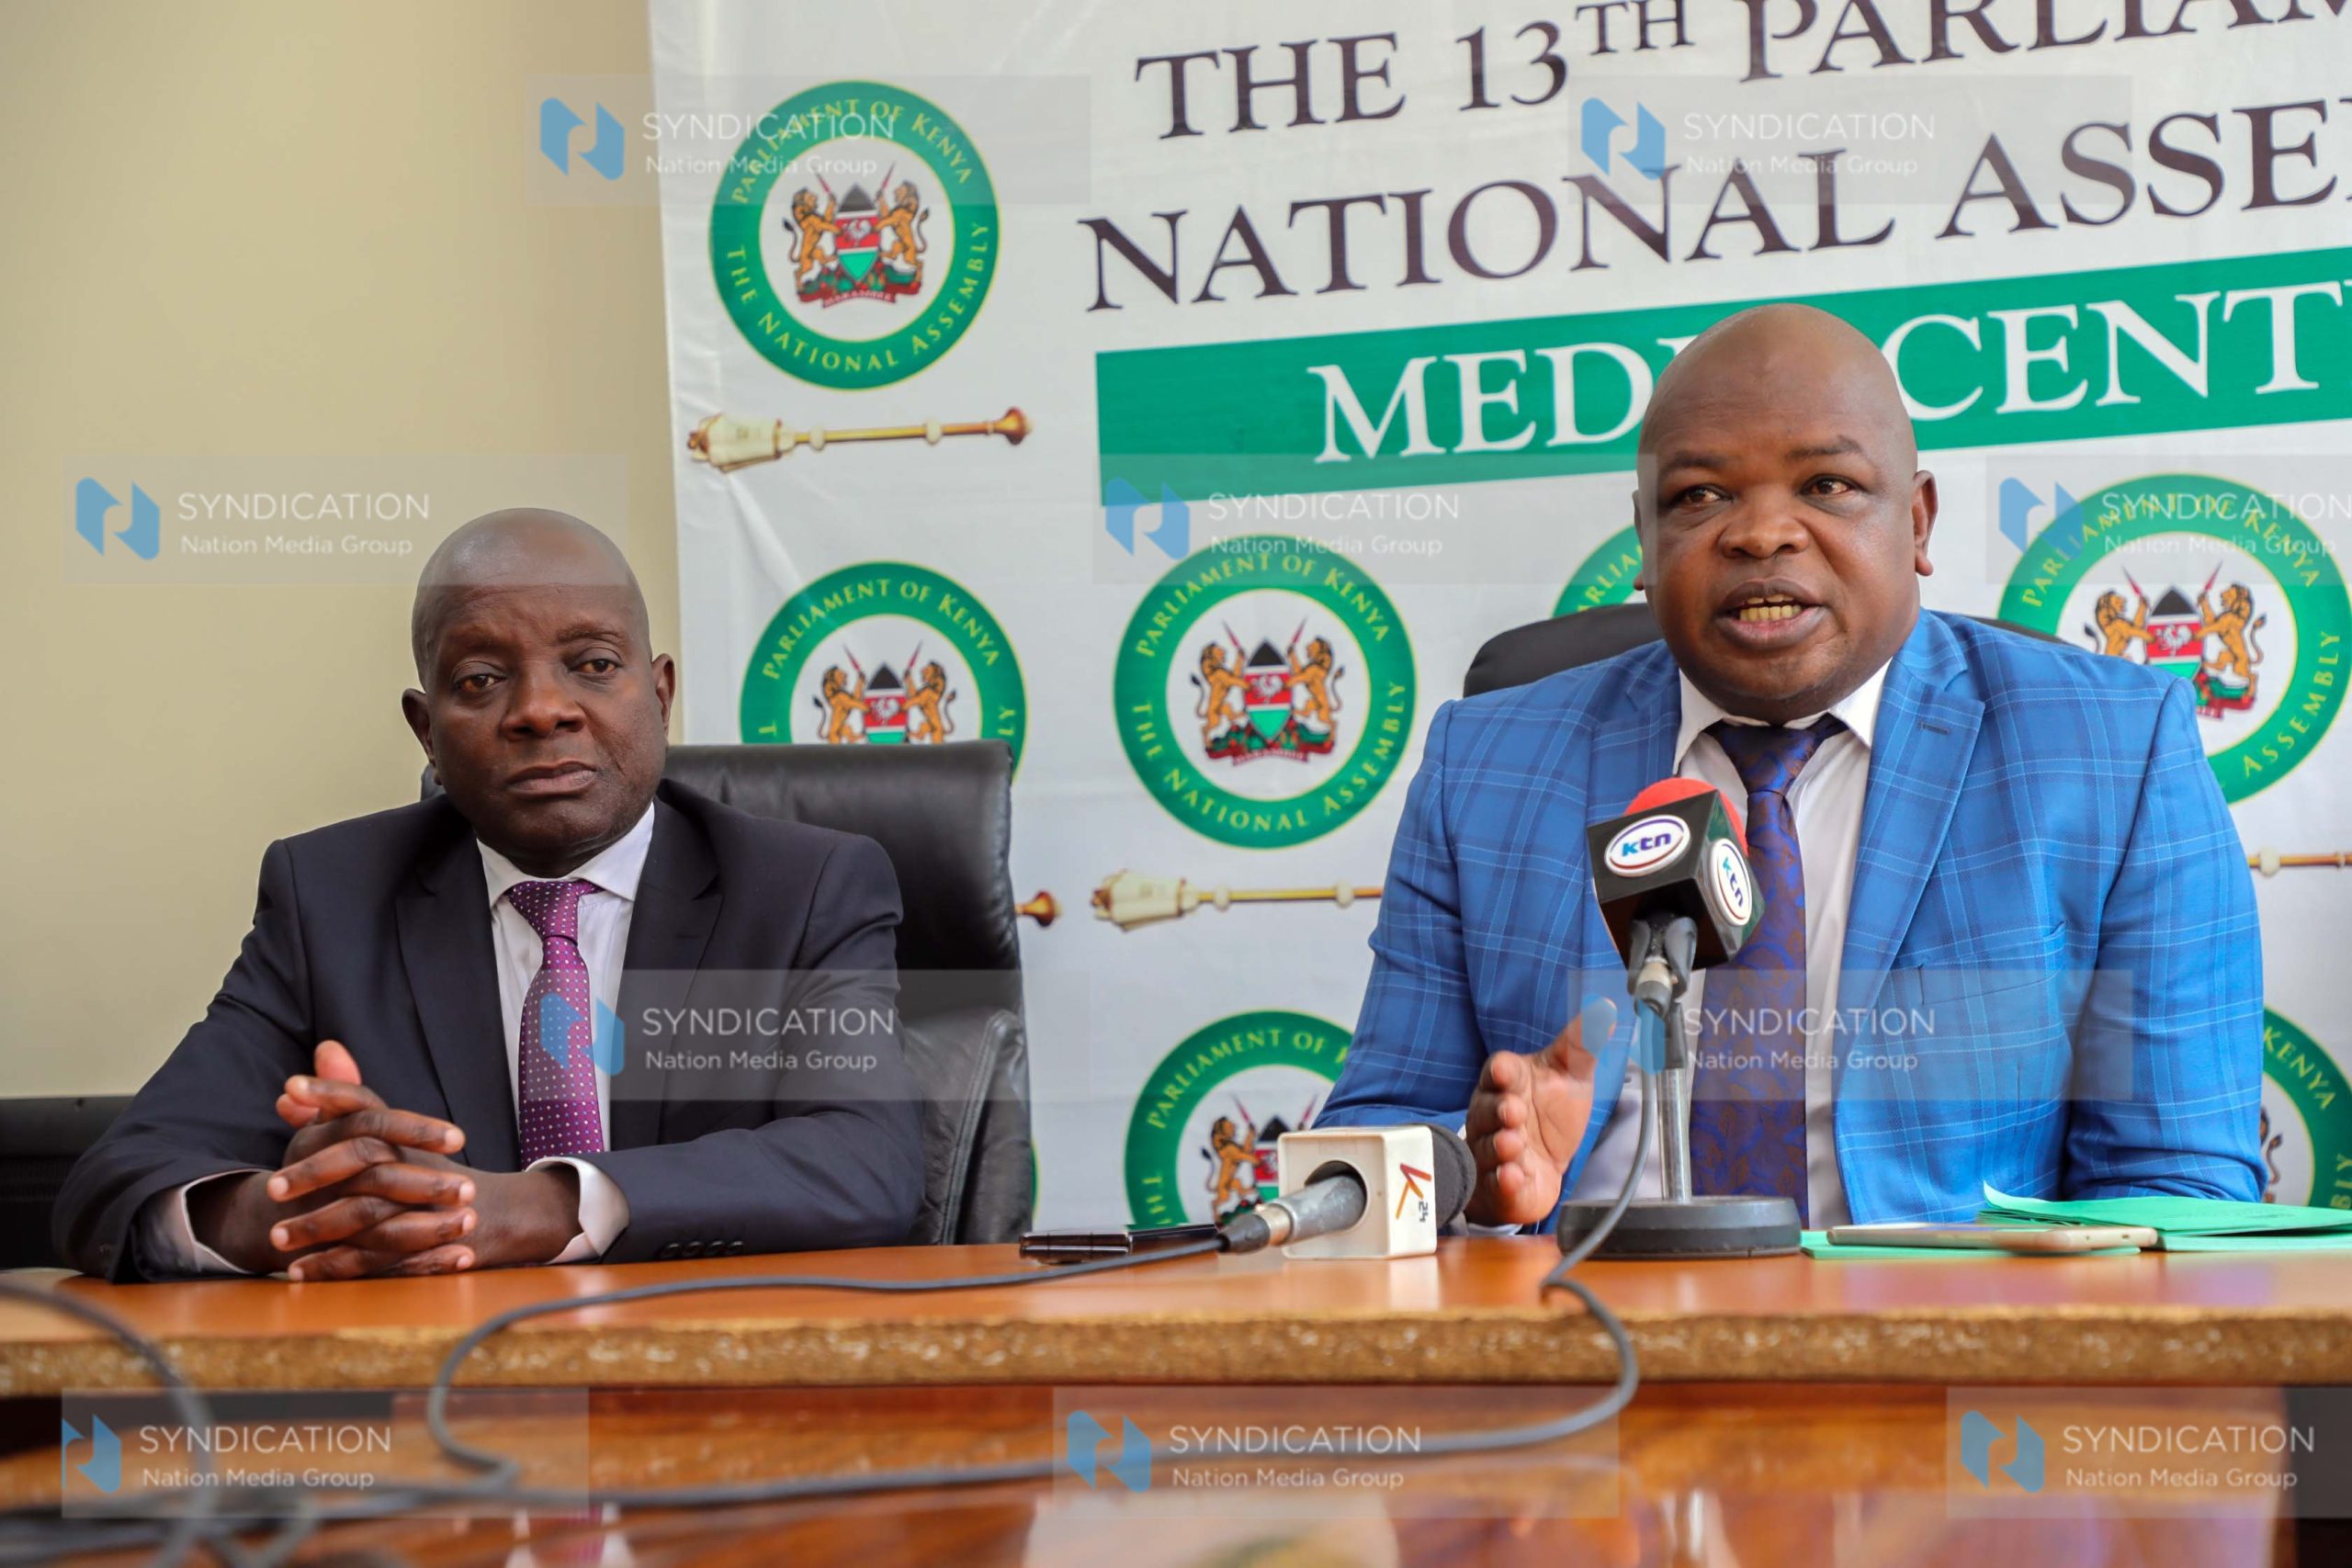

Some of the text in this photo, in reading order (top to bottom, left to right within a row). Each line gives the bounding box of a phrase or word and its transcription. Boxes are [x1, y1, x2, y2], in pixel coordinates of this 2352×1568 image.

[1135, 32, 1407, 141] THE
[732, 98, 973, 204] PARLIAMENT OF KENYA
[1077, 97, 2351, 312] NATIONAL ASSE
[727, 222, 989, 373] THE NATIONAL ASSEMBLY
[1306, 279, 2351, 464] MED CENT
[1136, 552, 1390, 658] PARLIAMENT OF KENYA
[2022, 494, 2179, 607] PARLIAMENT
[2245, 508, 2321, 588] KENYA
[762, 579, 1001, 680] PARLIAMENT OF KENYA
[1133, 682, 1407, 832] THE NATIONAL ASSEMBLY
[2242, 630, 2341, 777] ASSEMBLY
[1146, 1028, 1328, 1129] PARLIAMENT OF
[2264, 1026, 2335, 1111] KENYA
